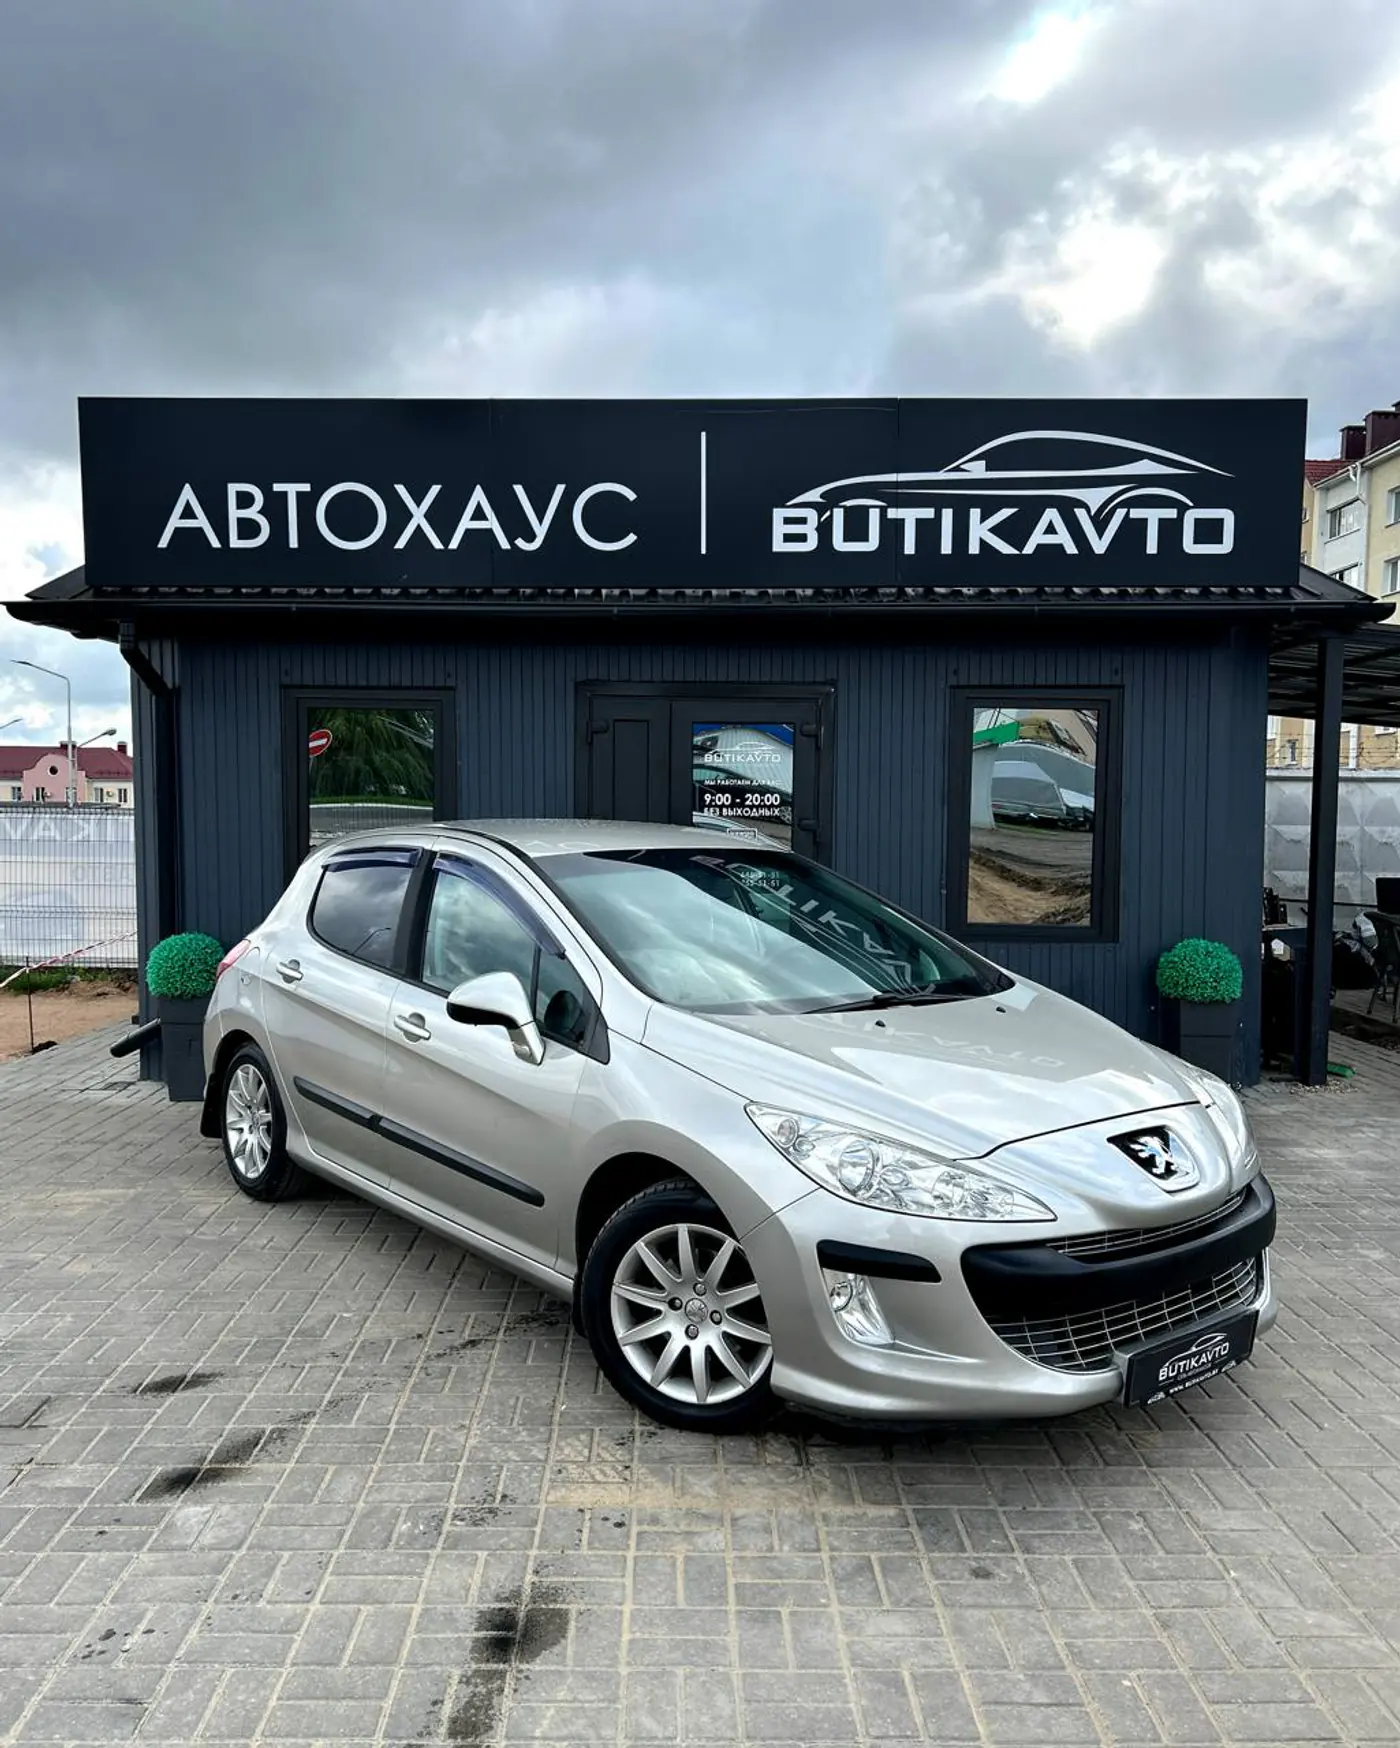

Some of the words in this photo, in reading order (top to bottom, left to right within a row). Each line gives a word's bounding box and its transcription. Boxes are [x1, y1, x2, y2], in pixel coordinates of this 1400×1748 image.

[158, 482, 637, 551] АВТОХАУС
[772, 508, 1235, 554] BUTIKAVTO
[704, 753, 781, 762] BUTIKAVTO
[704, 793, 731, 805] 9:00
[744, 793, 780, 805] 20:00
[704, 808, 720, 816] БЕЗ
[722, 807, 780, 816] ВЫХОДНЫХ
[1158, 1342, 1229, 1381] BUTIKAVTO
